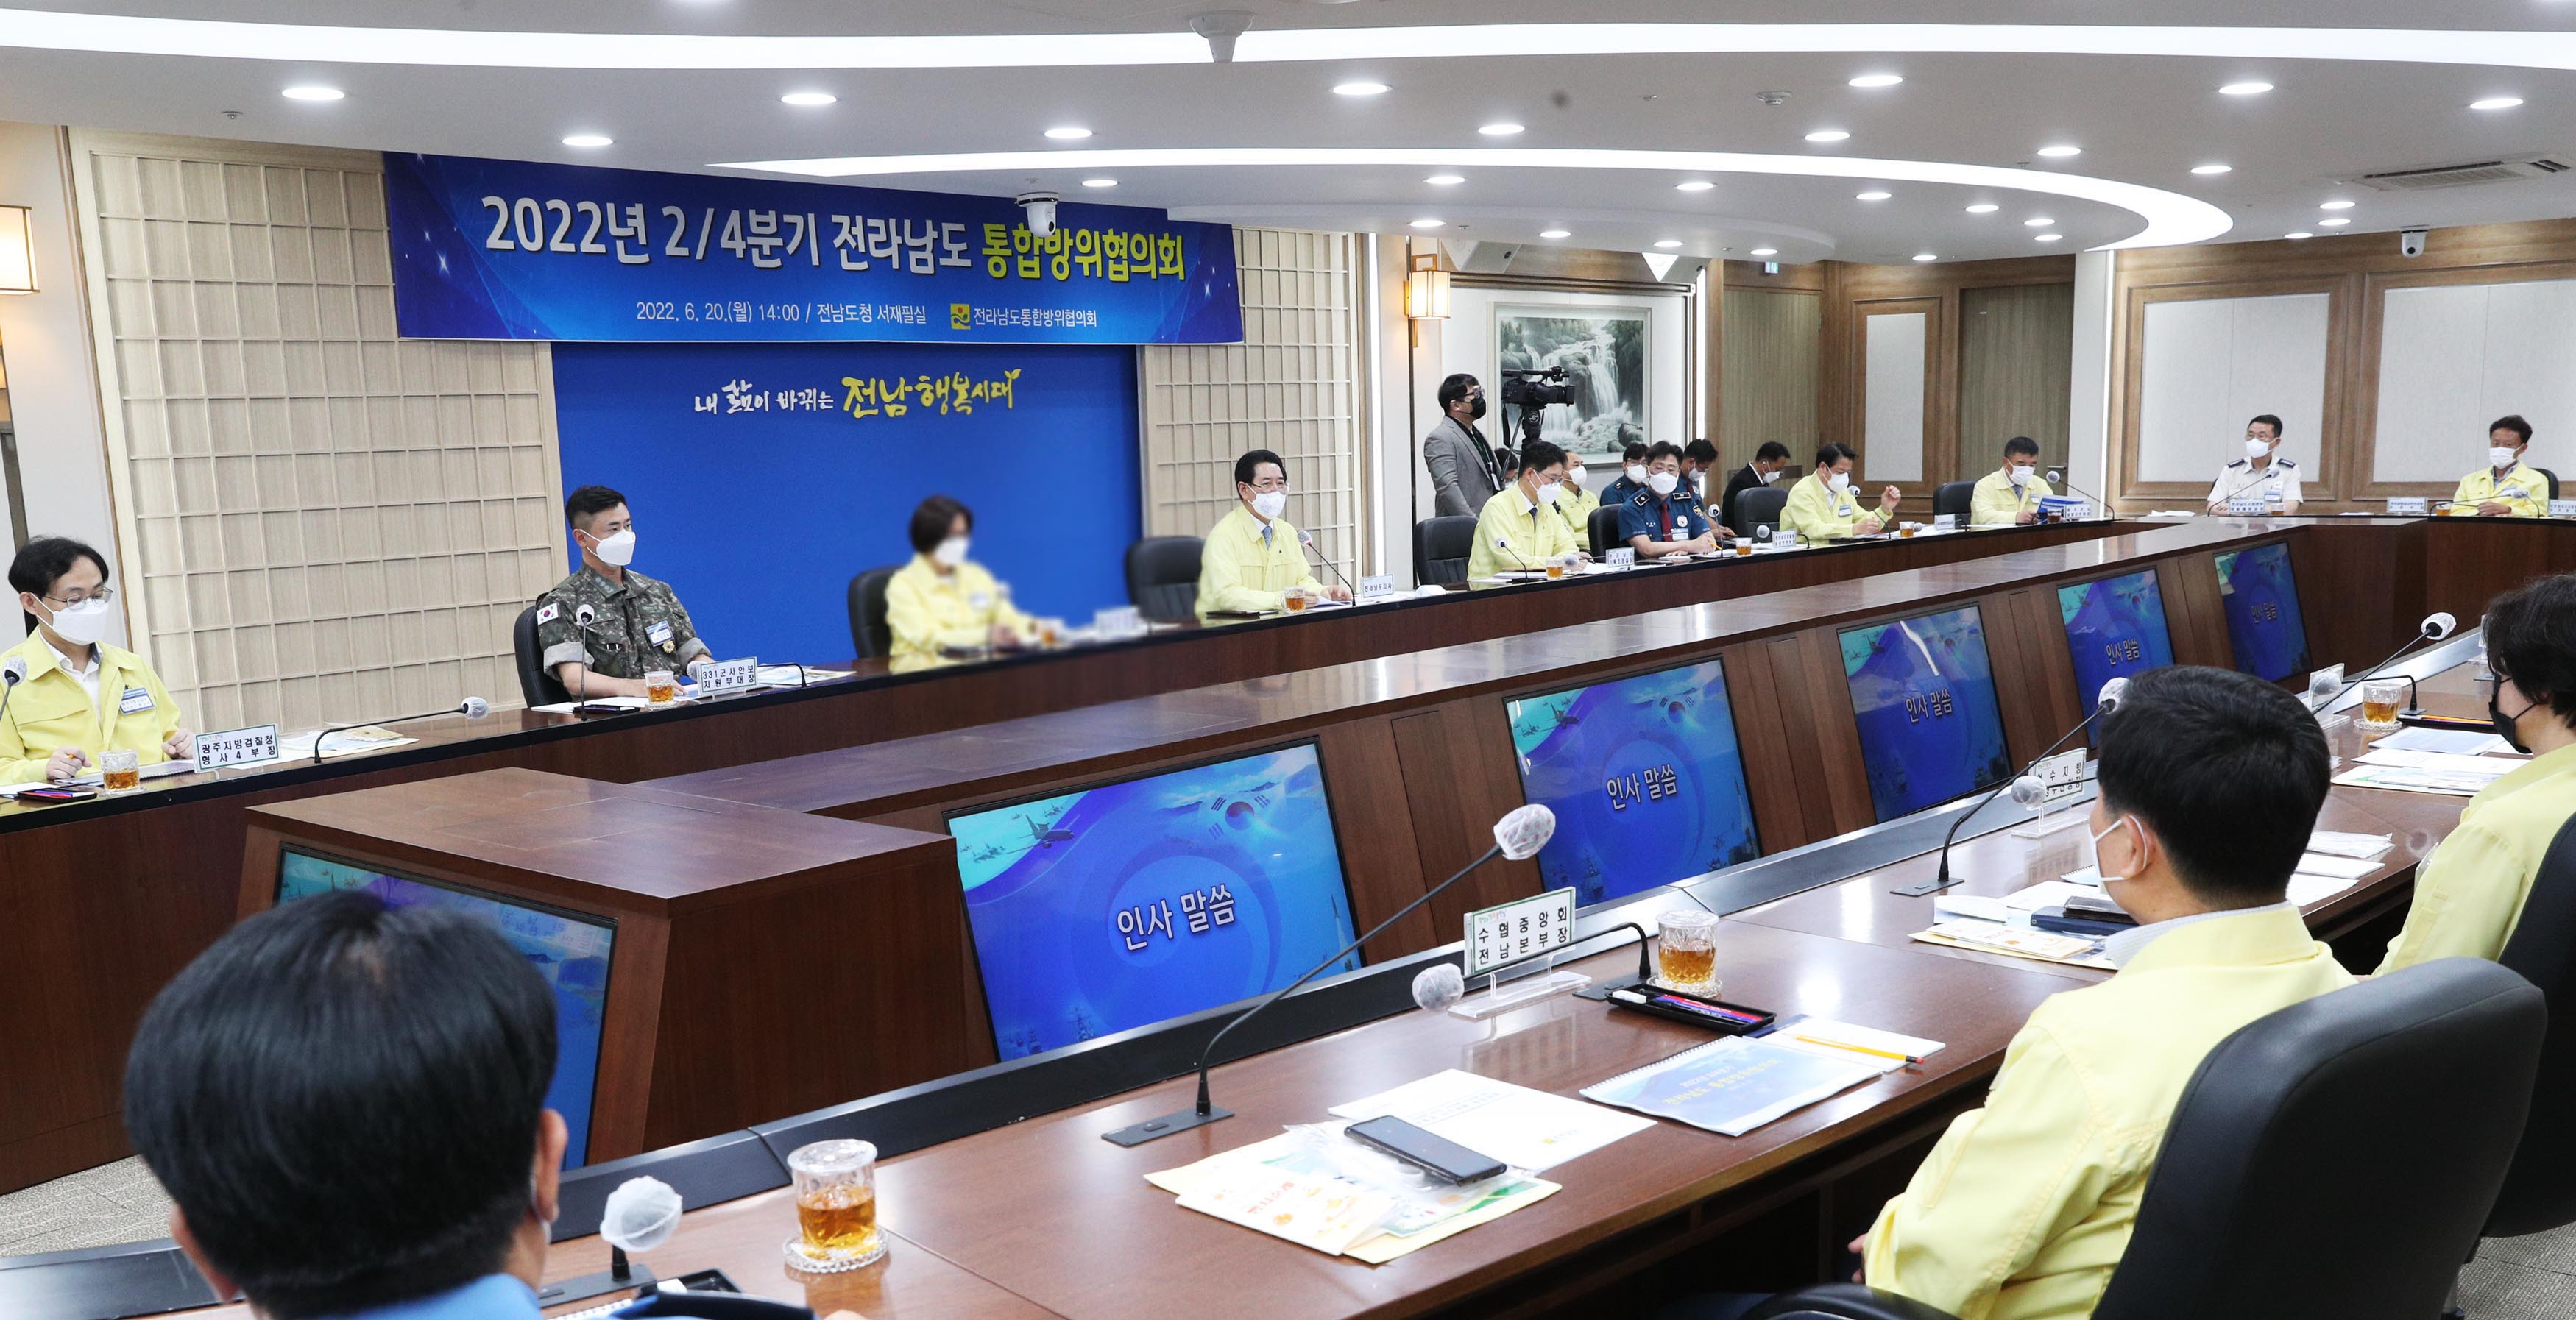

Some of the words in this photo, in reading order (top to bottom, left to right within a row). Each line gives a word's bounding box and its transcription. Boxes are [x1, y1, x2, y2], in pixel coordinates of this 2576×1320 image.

[481, 195, 651, 264] 2022년
[832, 213, 972, 274] 전라남도
[982, 222, 1184, 282] 통합방위협의회
[637, 302, 679, 321] 2022.
[684, 303, 698, 321] 6.
[704, 301, 752, 323] 20.(월)
[759, 303, 799, 322] 14:00
[805, 302, 811, 323] /
[817, 303, 873, 323] 전남도청
[877, 304, 927, 324] 서재필실
[974, 308, 1097, 327] 전라남도통합방위협의회
[694, 392, 718, 414] 내
[721, 379, 769, 414] 삶이
[776, 388, 833, 411] 바뀌는
[2106, 642, 2123, 665] 인사
[2123, 637, 2140, 661] 말씀
[1906, 694, 1928, 723] 인사
[1930, 688, 1952, 717] 말씀
[202, 734, 273, 754] 광주지방검찰청
[1607, 773, 1641, 810] 인사
[1643, 764, 1677, 801] 말씀
[1117, 899, 1173, 951] 인사
[1180, 883, 1236, 934] 말씀
[1479, 928, 1568, 965] 전남본부장
